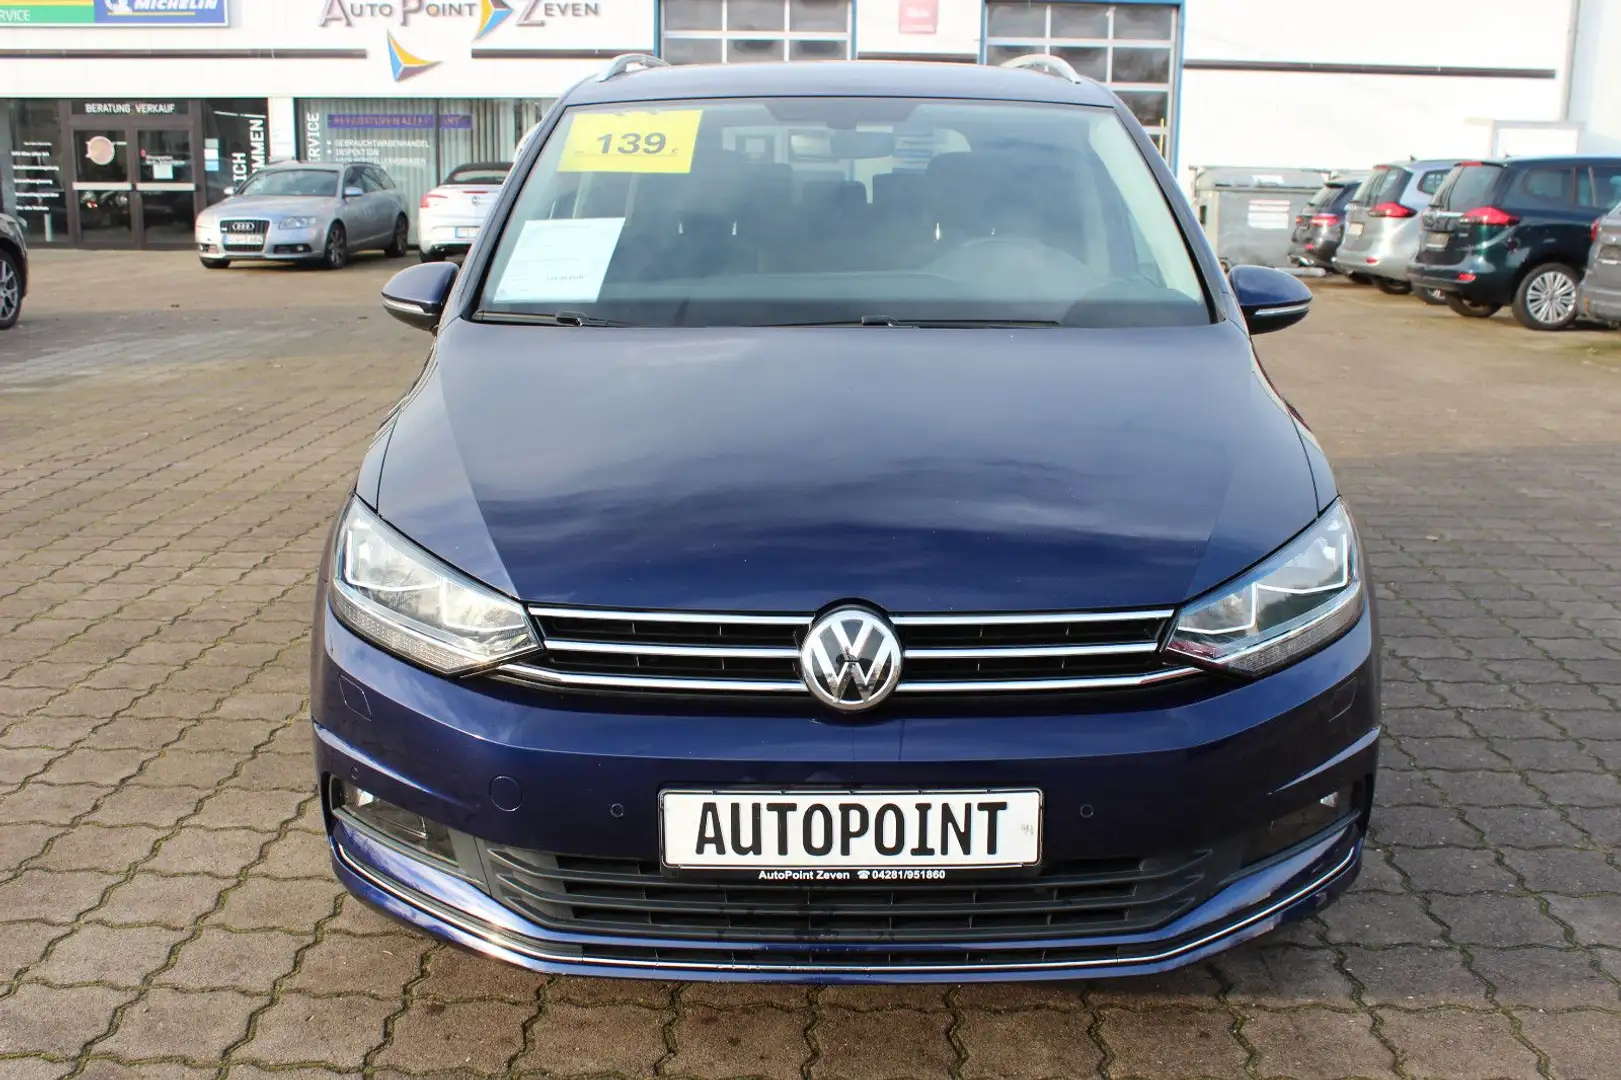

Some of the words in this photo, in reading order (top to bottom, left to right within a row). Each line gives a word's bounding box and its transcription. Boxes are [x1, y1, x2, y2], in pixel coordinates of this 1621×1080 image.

[133, 0, 218, 10] MICHELIN
[85, 103, 131, 113] BERATUNG
[135, 103, 175, 113] VERKAUF
[249, 119, 265, 173] MMEN
[597, 132, 667, 155] 139
[695, 802, 1008, 857] AUTOPOINT
[758, 870, 814, 880] AutoPoint
[816, 870, 850, 880] Zeven
[872, 870, 946, 880] 04281/951860
